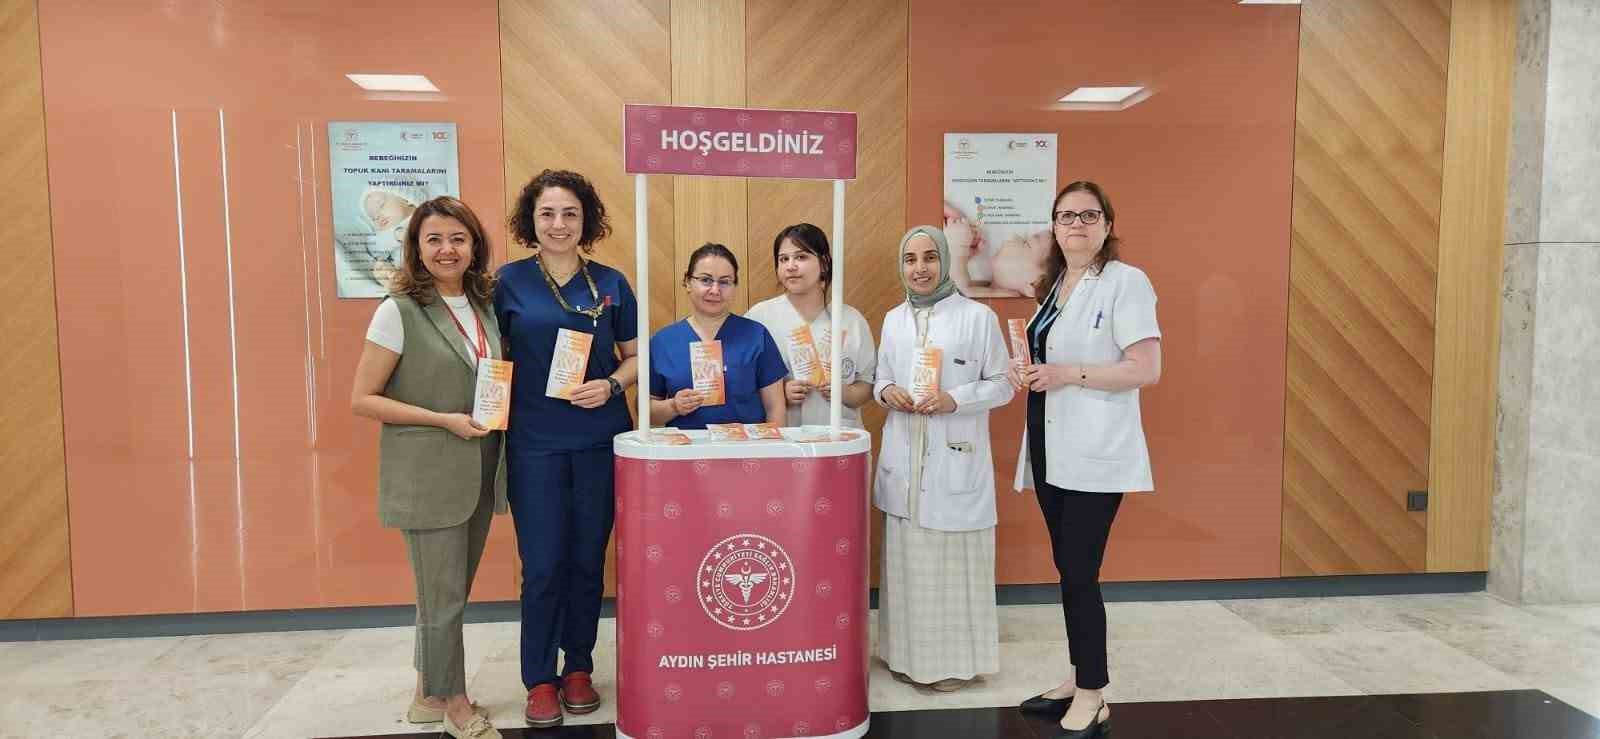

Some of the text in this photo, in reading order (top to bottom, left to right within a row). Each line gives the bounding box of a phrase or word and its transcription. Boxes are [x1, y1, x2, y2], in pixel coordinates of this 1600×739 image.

[660, 128, 824, 156] HOŞGELDİNİZ
[659, 644, 837, 669] AYDIN ŞEHİR HASTANESİ
